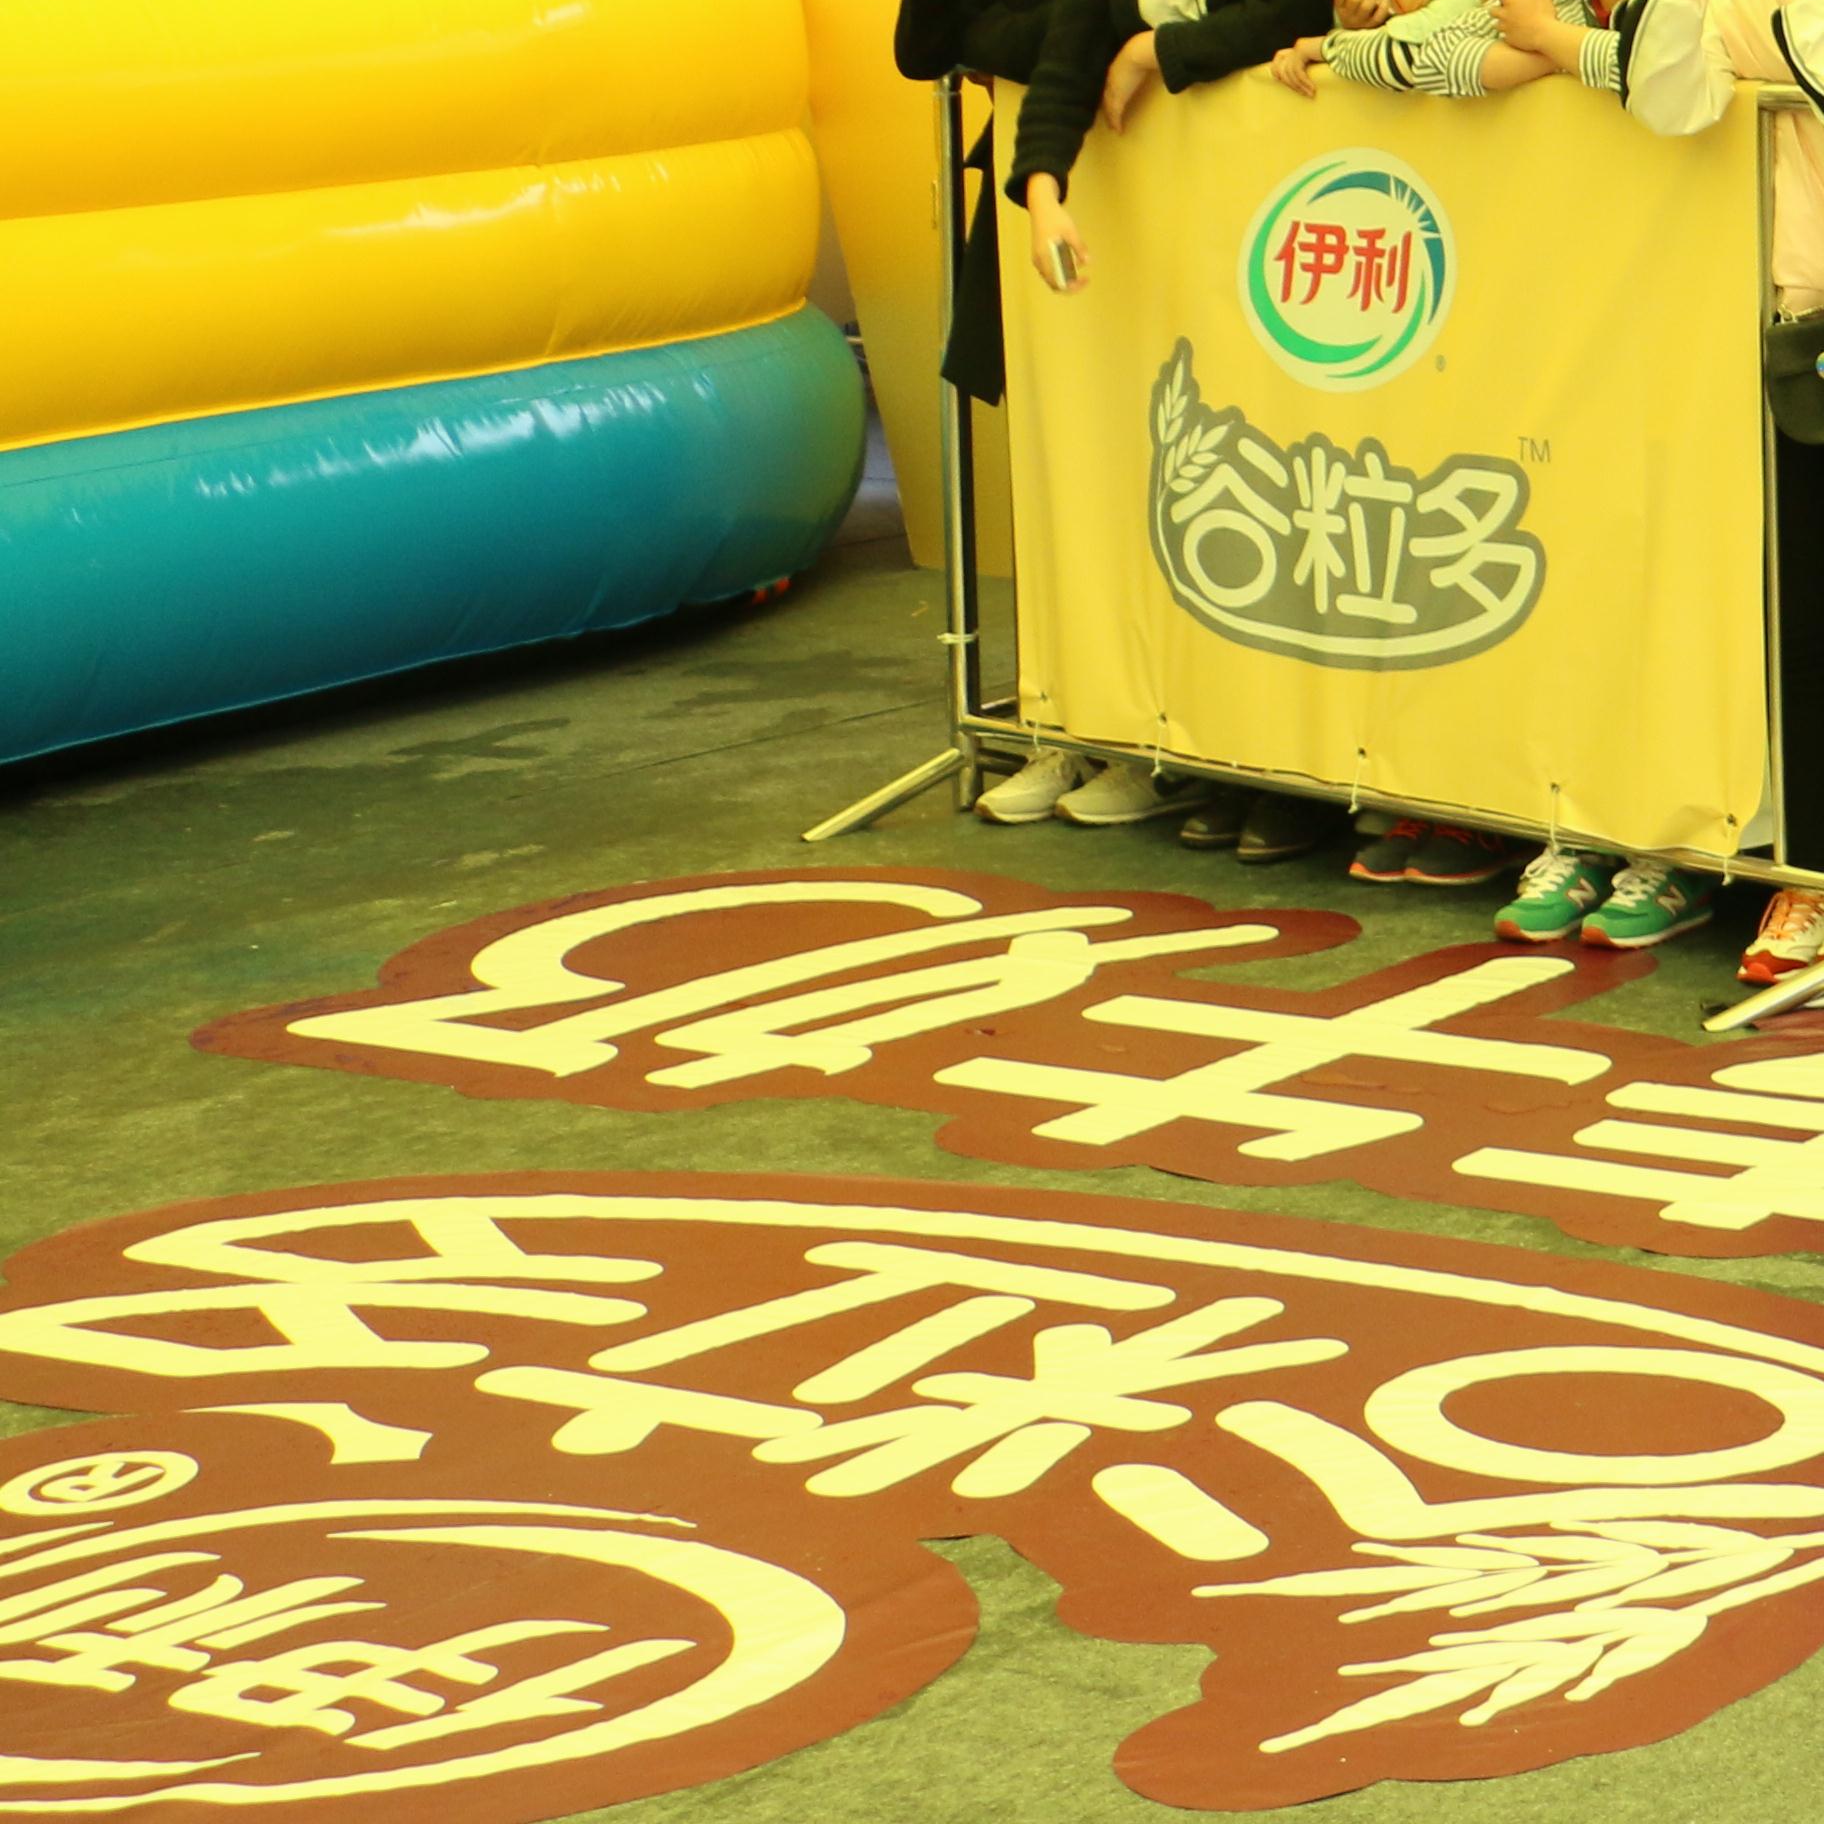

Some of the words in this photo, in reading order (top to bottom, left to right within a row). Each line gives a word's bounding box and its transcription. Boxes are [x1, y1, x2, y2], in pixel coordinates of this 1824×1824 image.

[1274, 219, 1413, 314] 伊利
[1171, 436, 1537, 626] 谷粒多
